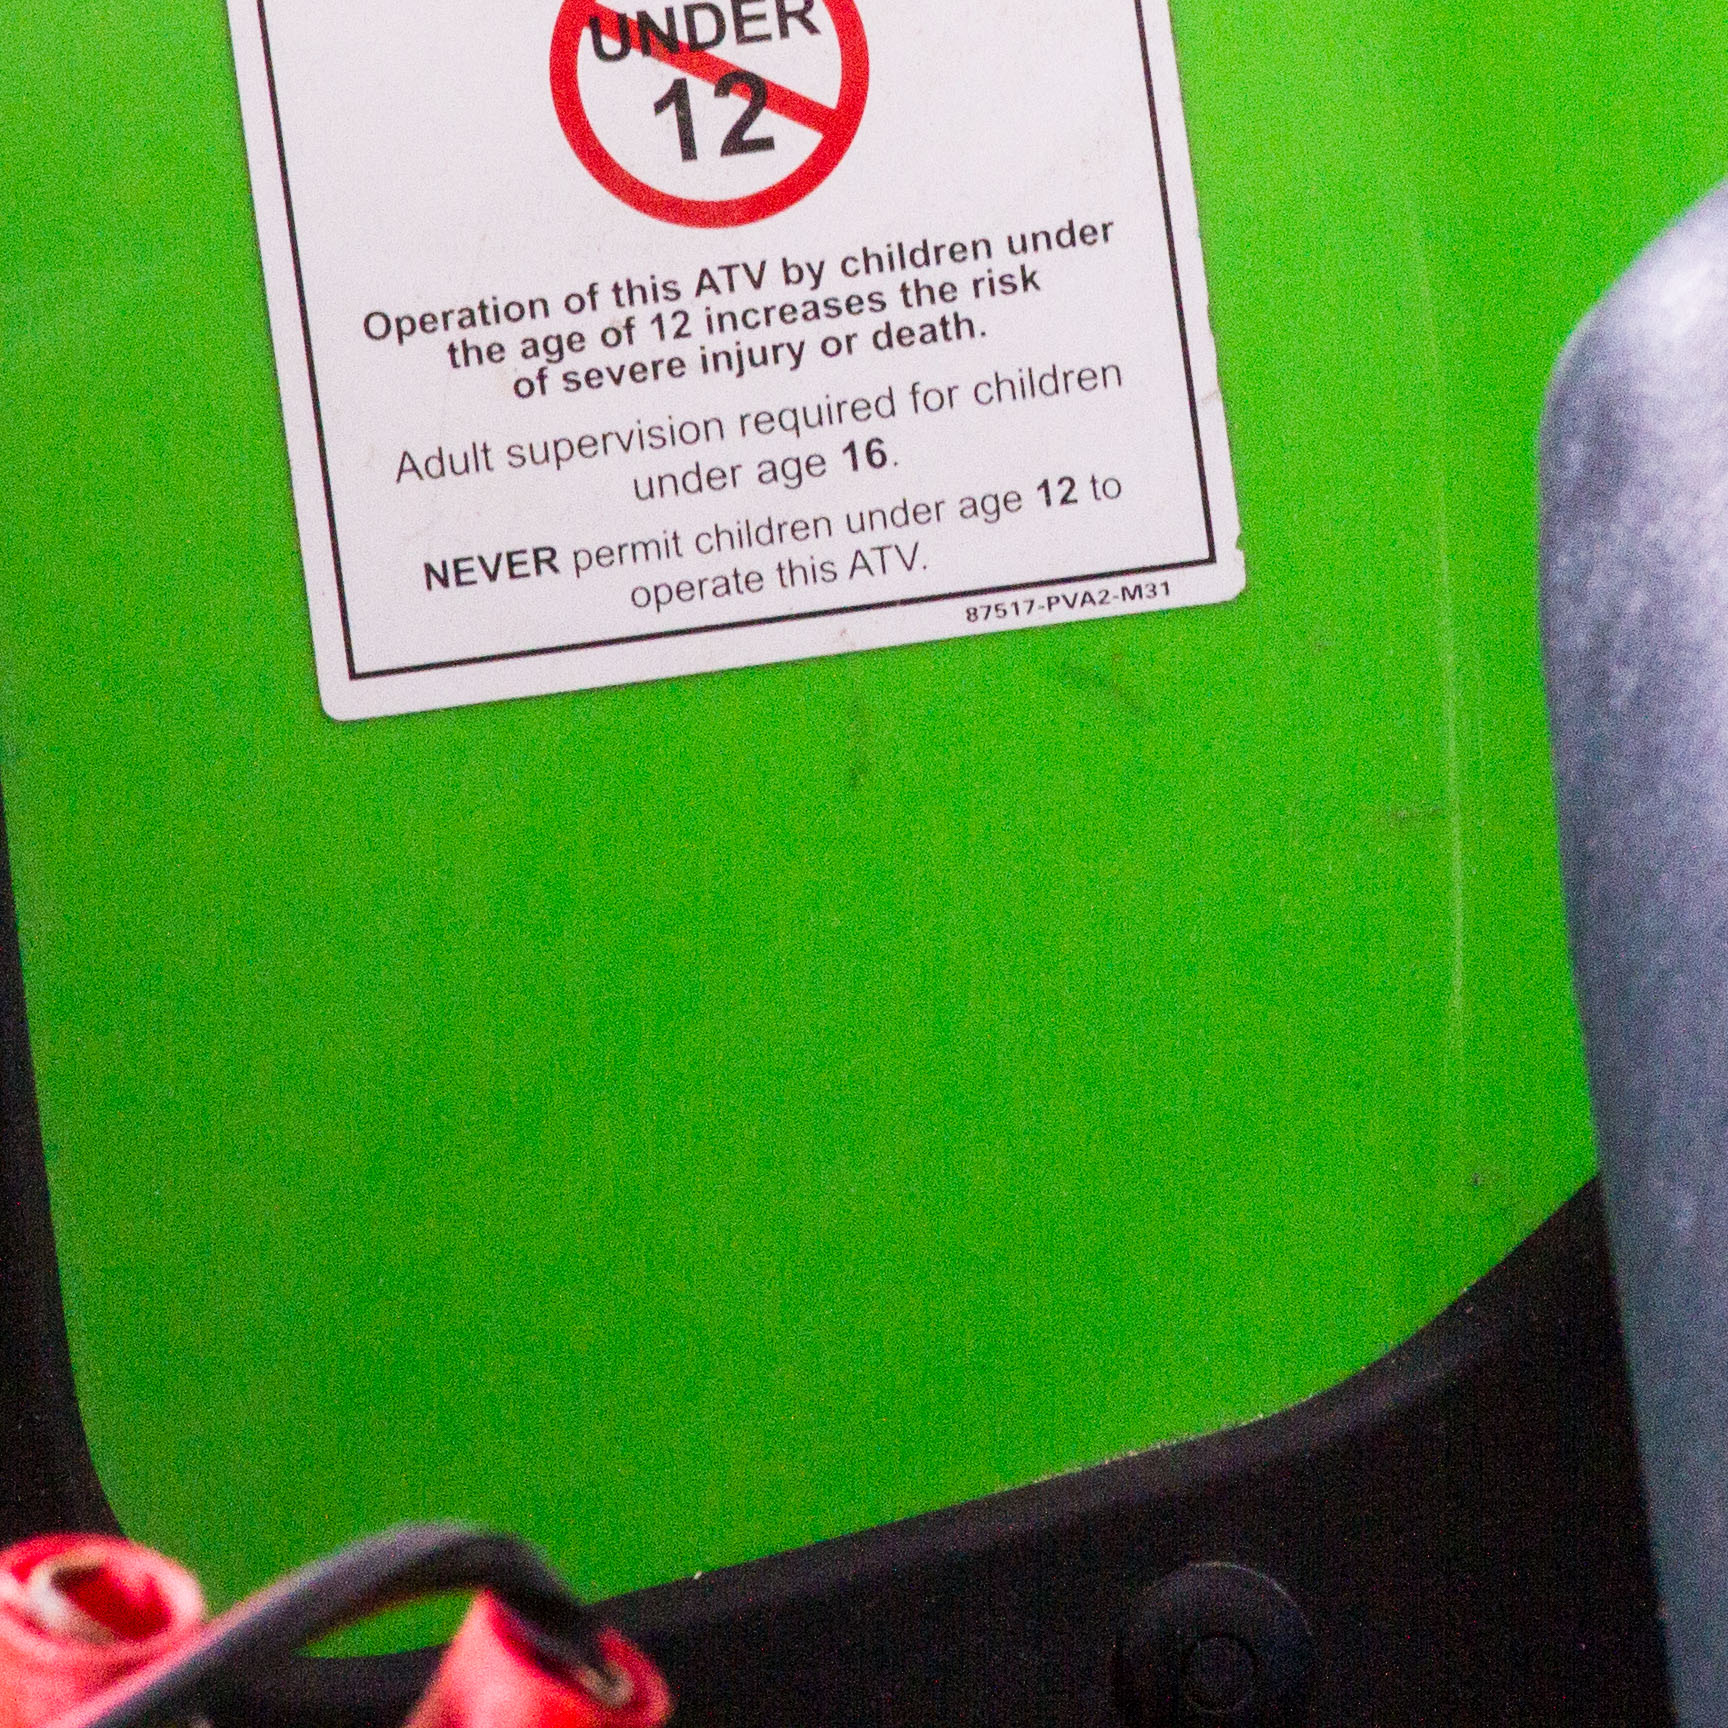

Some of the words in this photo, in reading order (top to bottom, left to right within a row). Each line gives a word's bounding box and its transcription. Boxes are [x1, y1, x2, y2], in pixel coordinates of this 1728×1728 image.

[653, 68, 776, 163] 12
[362, 295, 551, 347] Operation
[563, 281, 599, 316] of
[611, 274, 682, 309] this
[694, 259, 767, 298] ATV
[781, 256, 826, 292] by
[840, 237, 993, 278] children
[1006, 218, 1114, 257] under
[446, 337, 506, 370] the
[520, 330, 587, 365] age
[600, 315, 636, 349] of
[650, 308, 692, 342] 12
[704, 290, 888, 336] increases
[899, 277, 958, 309] the
[972, 263, 1041, 300] risk
[512, 365, 549, 400] of
[561, 356, 687, 394] severe
[699, 339, 806, 379] injury
[820, 332, 859, 358] or
[871, 310, 987, 352] death.
[395, 441, 495, 484] Adult
[506, 414, 725, 472] supervision
[739, 385, 897, 439] required
[909, 380, 959, 414] for
[973, 363, 1123, 406] children
[633, 460, 742, 502] under
[757, 453, 827, 491] age
[841, 436, 899, 473] 16.
[423, 545, 561, 592] NEVER
[572, 529, 684, 579] permit
[694, 515, 833, 555] children
[845, 497, 946, 535] under
[959, 490, 1023, 525] age
[1036, 475, 1079, 508] 12
[1089, 474, 1123, 502] to
[630, 567, 765, 614] operate
[775, 555, 839, 589] this
[848, 541, 927, 580] ATV.
[965, 580, 1171, 622] 87517-PVA2-M31
